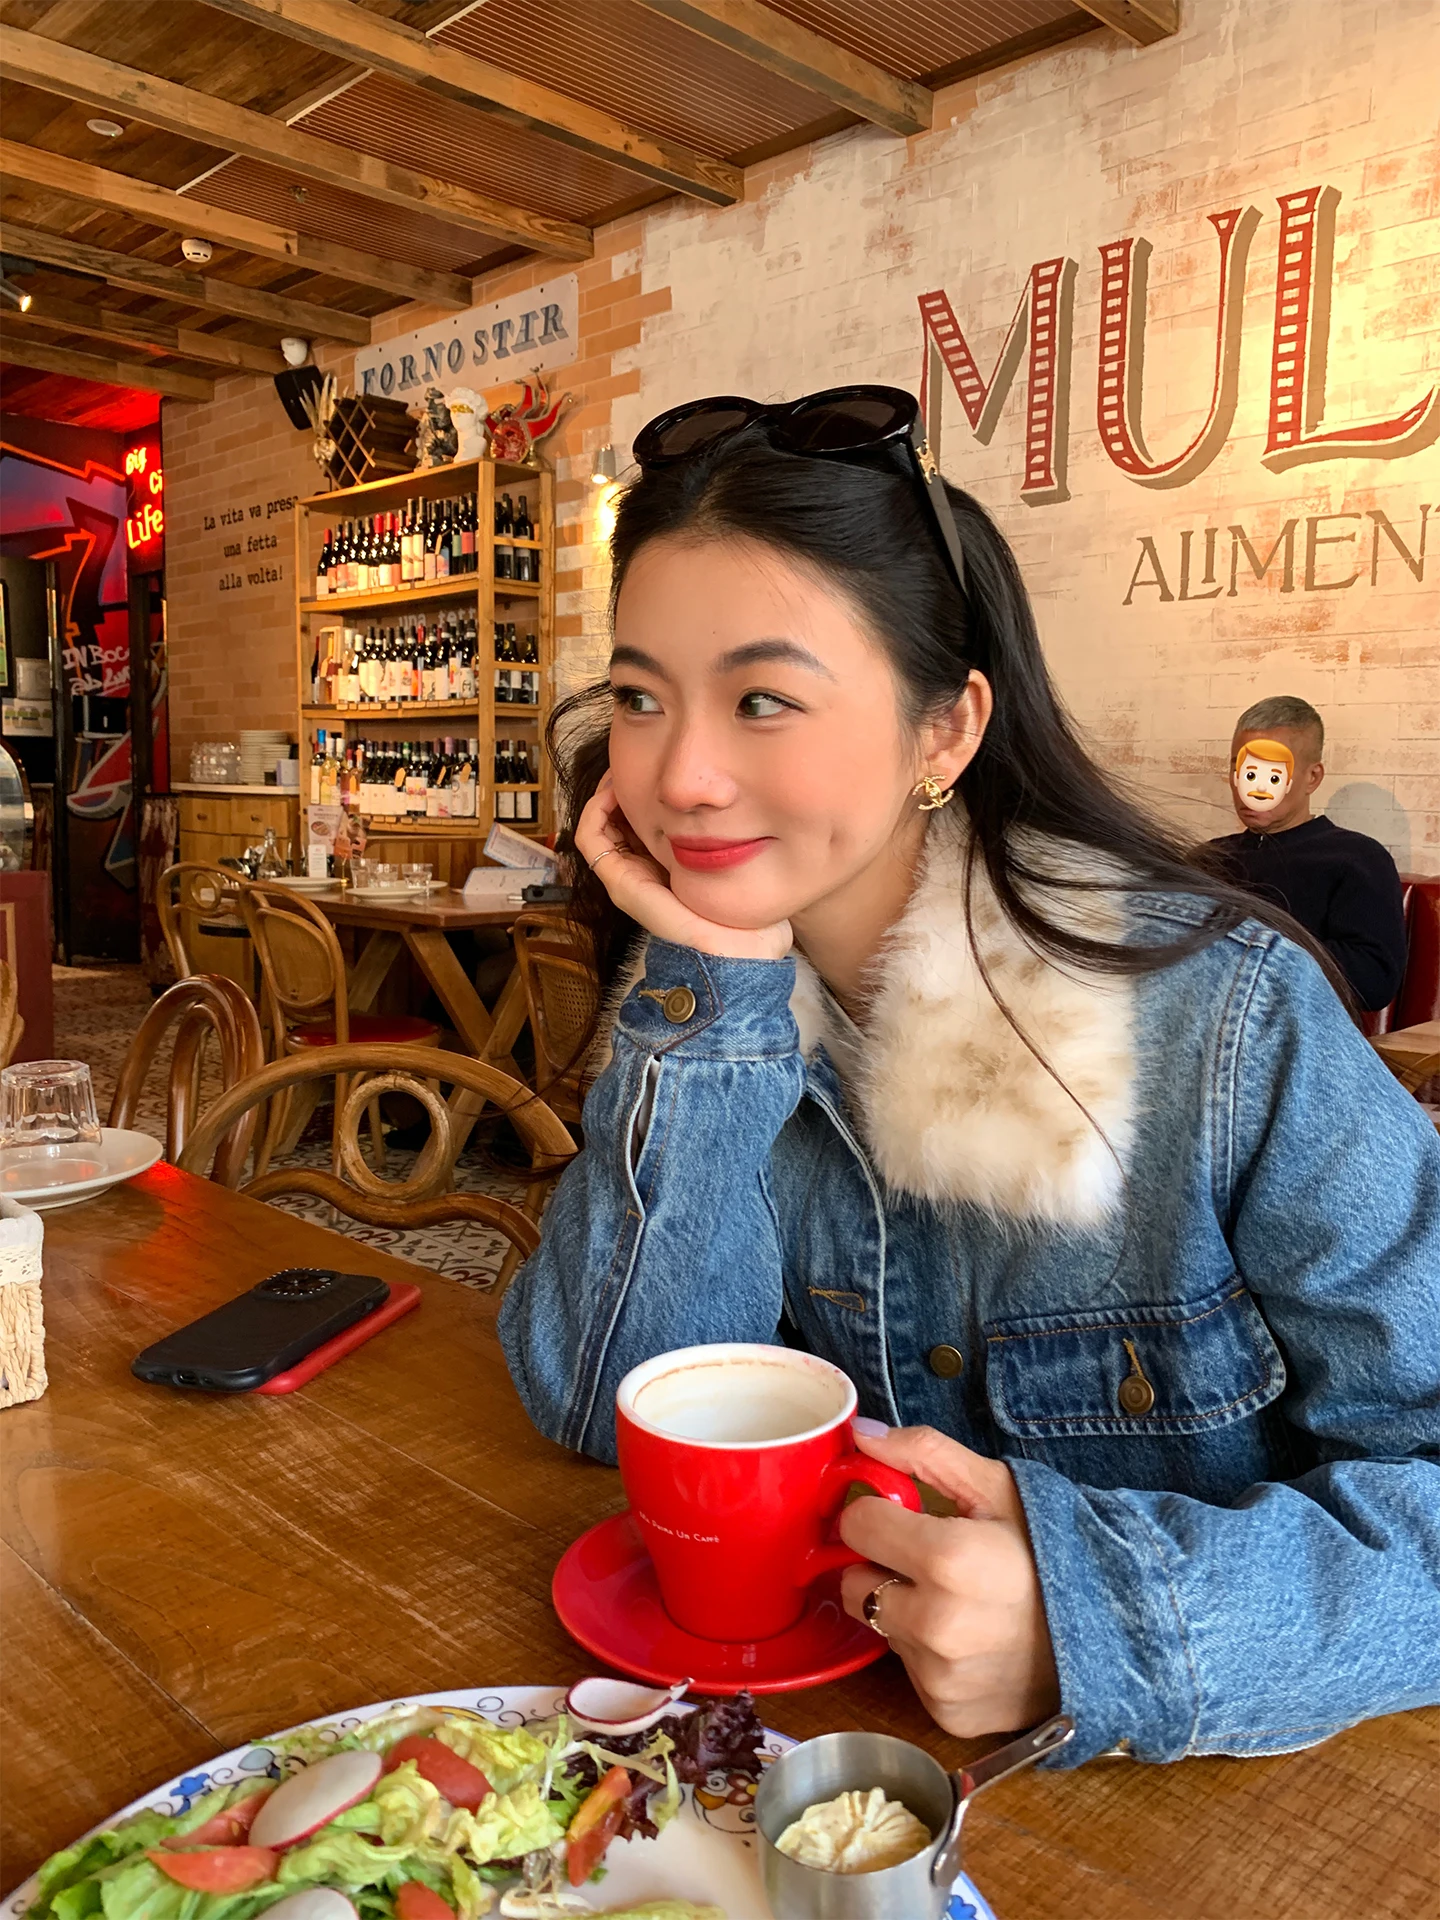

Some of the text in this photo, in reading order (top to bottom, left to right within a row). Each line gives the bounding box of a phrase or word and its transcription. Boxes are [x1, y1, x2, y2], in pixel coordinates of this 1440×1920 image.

[361, 303, 569, 395] FORNO STAR
[917, 184, 1440, 508] MUL
[126, 503, 164, 549] Life
[203, 516, 216, 531] La
[220, 508, 244, 526] vita
[249, 504, 262, 519] va
[223, 535, 277, 558] una fetta
[1122, 504, 1440, 606] ALIMEN
[219, 564, 283, 591] alla volta!
